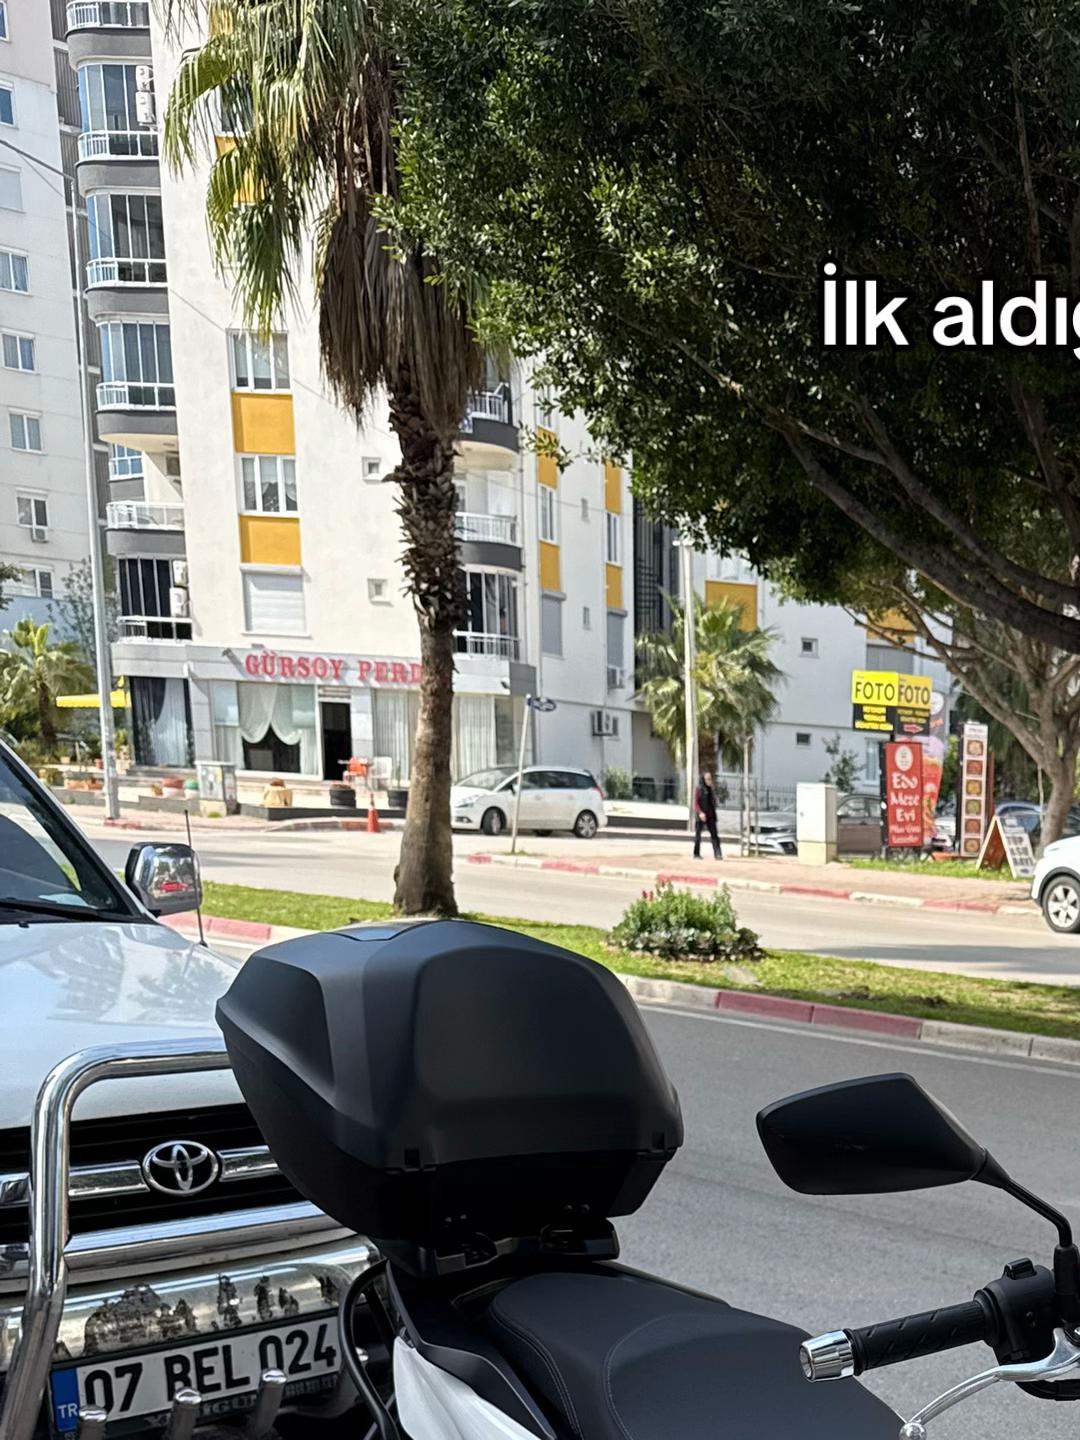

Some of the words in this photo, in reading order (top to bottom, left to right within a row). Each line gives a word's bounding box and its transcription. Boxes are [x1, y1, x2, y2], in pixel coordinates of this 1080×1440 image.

[245, 651, 344, 680] GÜRSOY
[855, 682, 895, 701] FOTO
[899, 685, 931, 705] FOTO
[84, 1361, 143, 1416] 07
[164, 1343, 250, 1403] BEL
[258, 1323, 337, 1376] 024
[57, 1403, 78, 1419] TR
